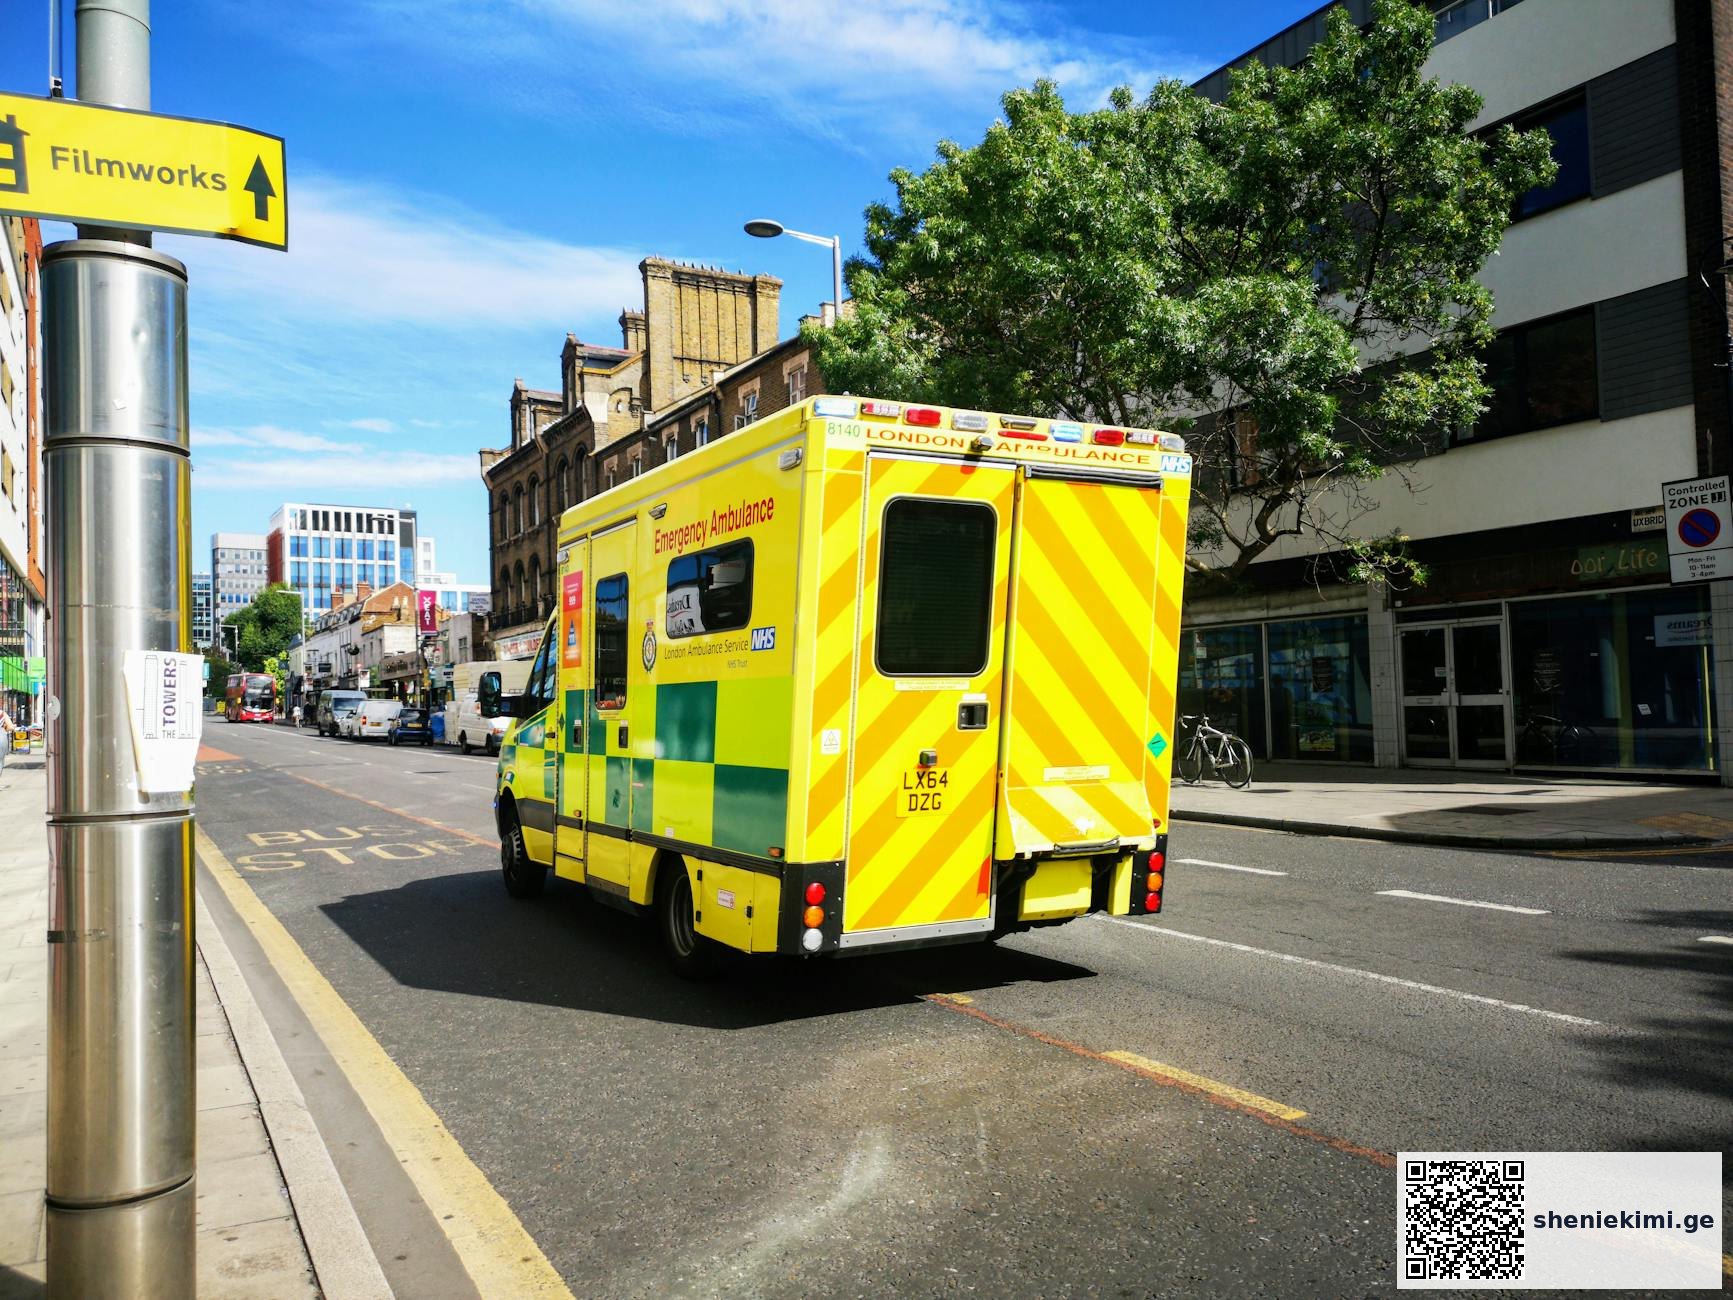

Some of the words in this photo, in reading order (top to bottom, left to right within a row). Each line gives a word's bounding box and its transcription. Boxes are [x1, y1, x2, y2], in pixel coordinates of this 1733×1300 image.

[51, 145, 228, 191] Filmworks
[828, 422, 861, 437] 8140
[866, 428, 964, 448] LONDON
[1161, 455, 1192, 473] NHS
[1668, 480, 1726, 496] Controlled
[1669, 494, 1709, 509] ZONE
[655, 520, 707, 554] Emergency
[710, 497, 774, 538] Ambulance
[1633, 515, 1664, 527] UXBRID
[752, 628, 775, 650] NHS
[664, 648, 686, 660] London
[688, 644, 722, 657] Ambulance
[725, 640, 749, 653] Service
[163, 657, 177, 727] TOWERS
[162, 729, 176, 739] THE
[903, 770, 949, 790] LX64
[908, 792, 942, 812] DZG
[247, 825, 417, 847] BUS
[236, 839, 477, 871] STOP
